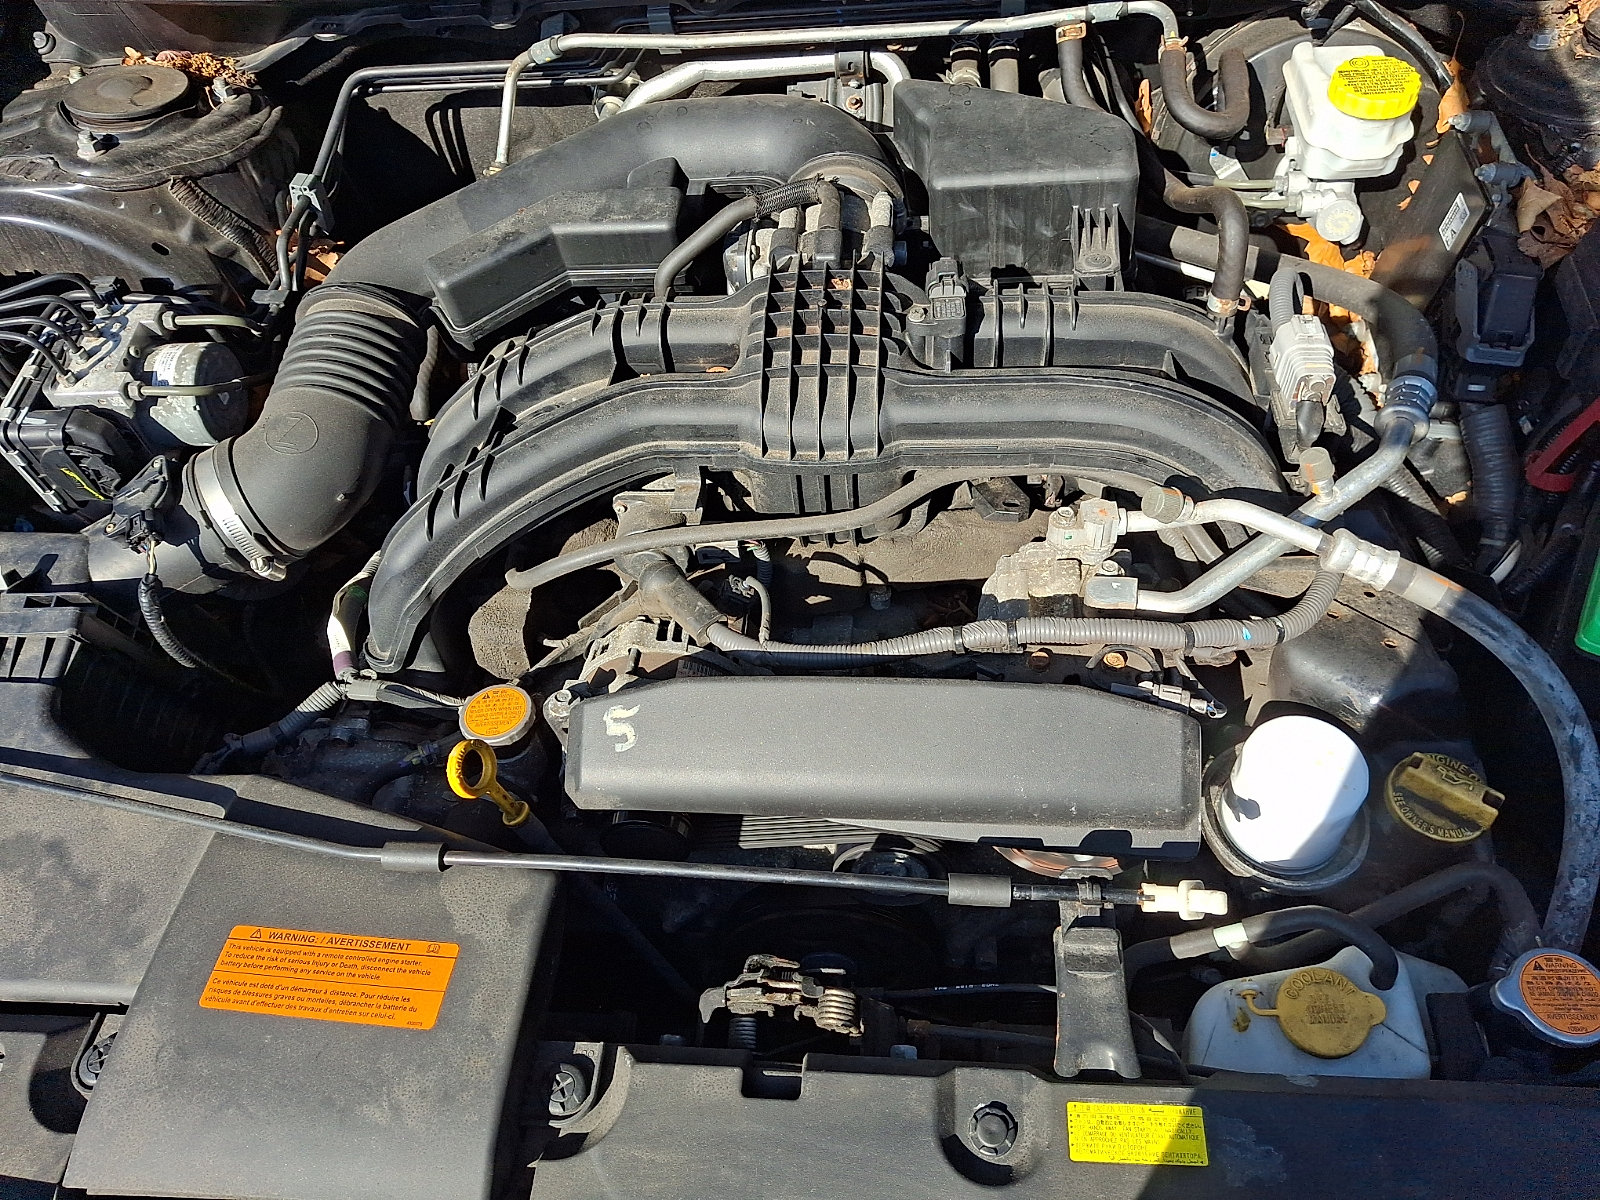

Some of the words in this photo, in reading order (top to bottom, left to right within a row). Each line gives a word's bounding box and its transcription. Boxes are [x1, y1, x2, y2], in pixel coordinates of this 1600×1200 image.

[603, 704, 640, 752] 5
[268, 931, 319, 943] WARNING:
[326, 936, 411, 951] AVERTISSEMENT
[272, 948, 302, 956] equipped
[220, 960, 243, 968] battery
[264, 964, 298, 974] performing
[339, 962, 359, 970] Death,
[360, 964, 395, 973] disconnect
[408, 968, 431, 976] vehicle
[290, 985, 323, 995] démarreur
[330, 990, 359, 998] distance.
[377, 993, 400, 1001] réduire
[1284, 971, 1357, 1000] COOLANT
[242, 990, 272, 999] blessures
[338, 999, 374, 1009] débrancher
[383, 1003, 407, 1012] batterie
[250, 1000, 284, 1009] d'effectuer
[322, 1006, 357, 1016] d'entretien
